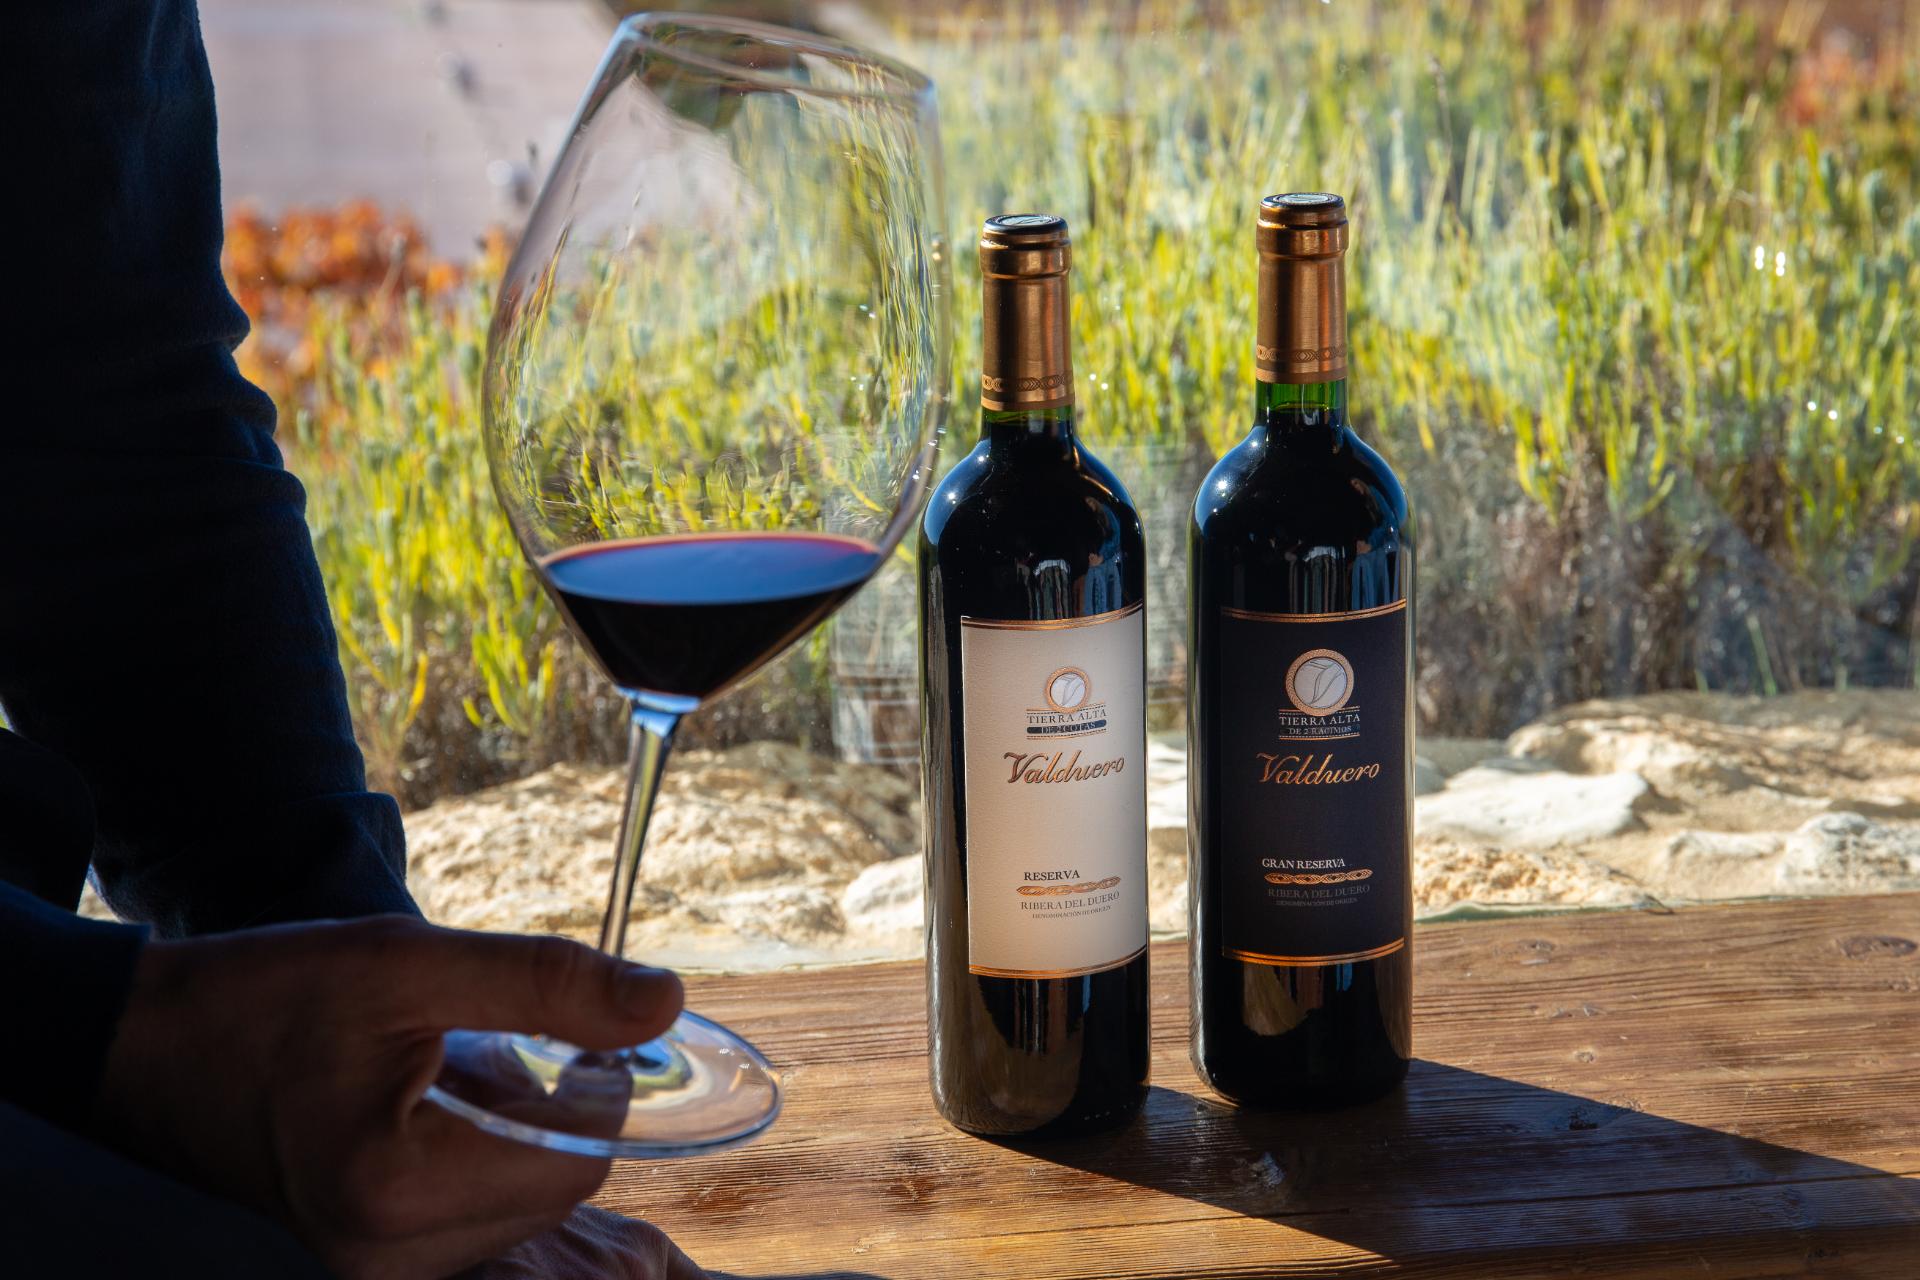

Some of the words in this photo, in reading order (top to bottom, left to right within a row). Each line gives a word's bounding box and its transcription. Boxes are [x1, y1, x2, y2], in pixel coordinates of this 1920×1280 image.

[1027, 714, 1074, 724] TIERRA
[1079, 709, 1107, 721] ALTA
[1279, 716, 1326, 726] TIERRA
[1330, 713, 1360, 724] ALTA
[1289, 727, 1301, 735] DE
[1311, 725, 1352, 736] RACIMOS
[1004, 750, 1125, 783] Valduero
[1256, 752, 1380, 785] Valduero
[1262, 858, 1295, 869] GRAN
[1297, 858, 1346, 869] RESERVA
[1024, 870, 1080, 881] RESERVA
[1268, 888, 1309, 899] RIBERA
[1311, 889, 1334, 898] DEL
[1335, 884, 1370, 896] DUERO
[1021, 901, 1062, 910] RIBERA
[1065, 899, 1086, 909] DEL
[1088, 891, 1120, 906] DUERO
